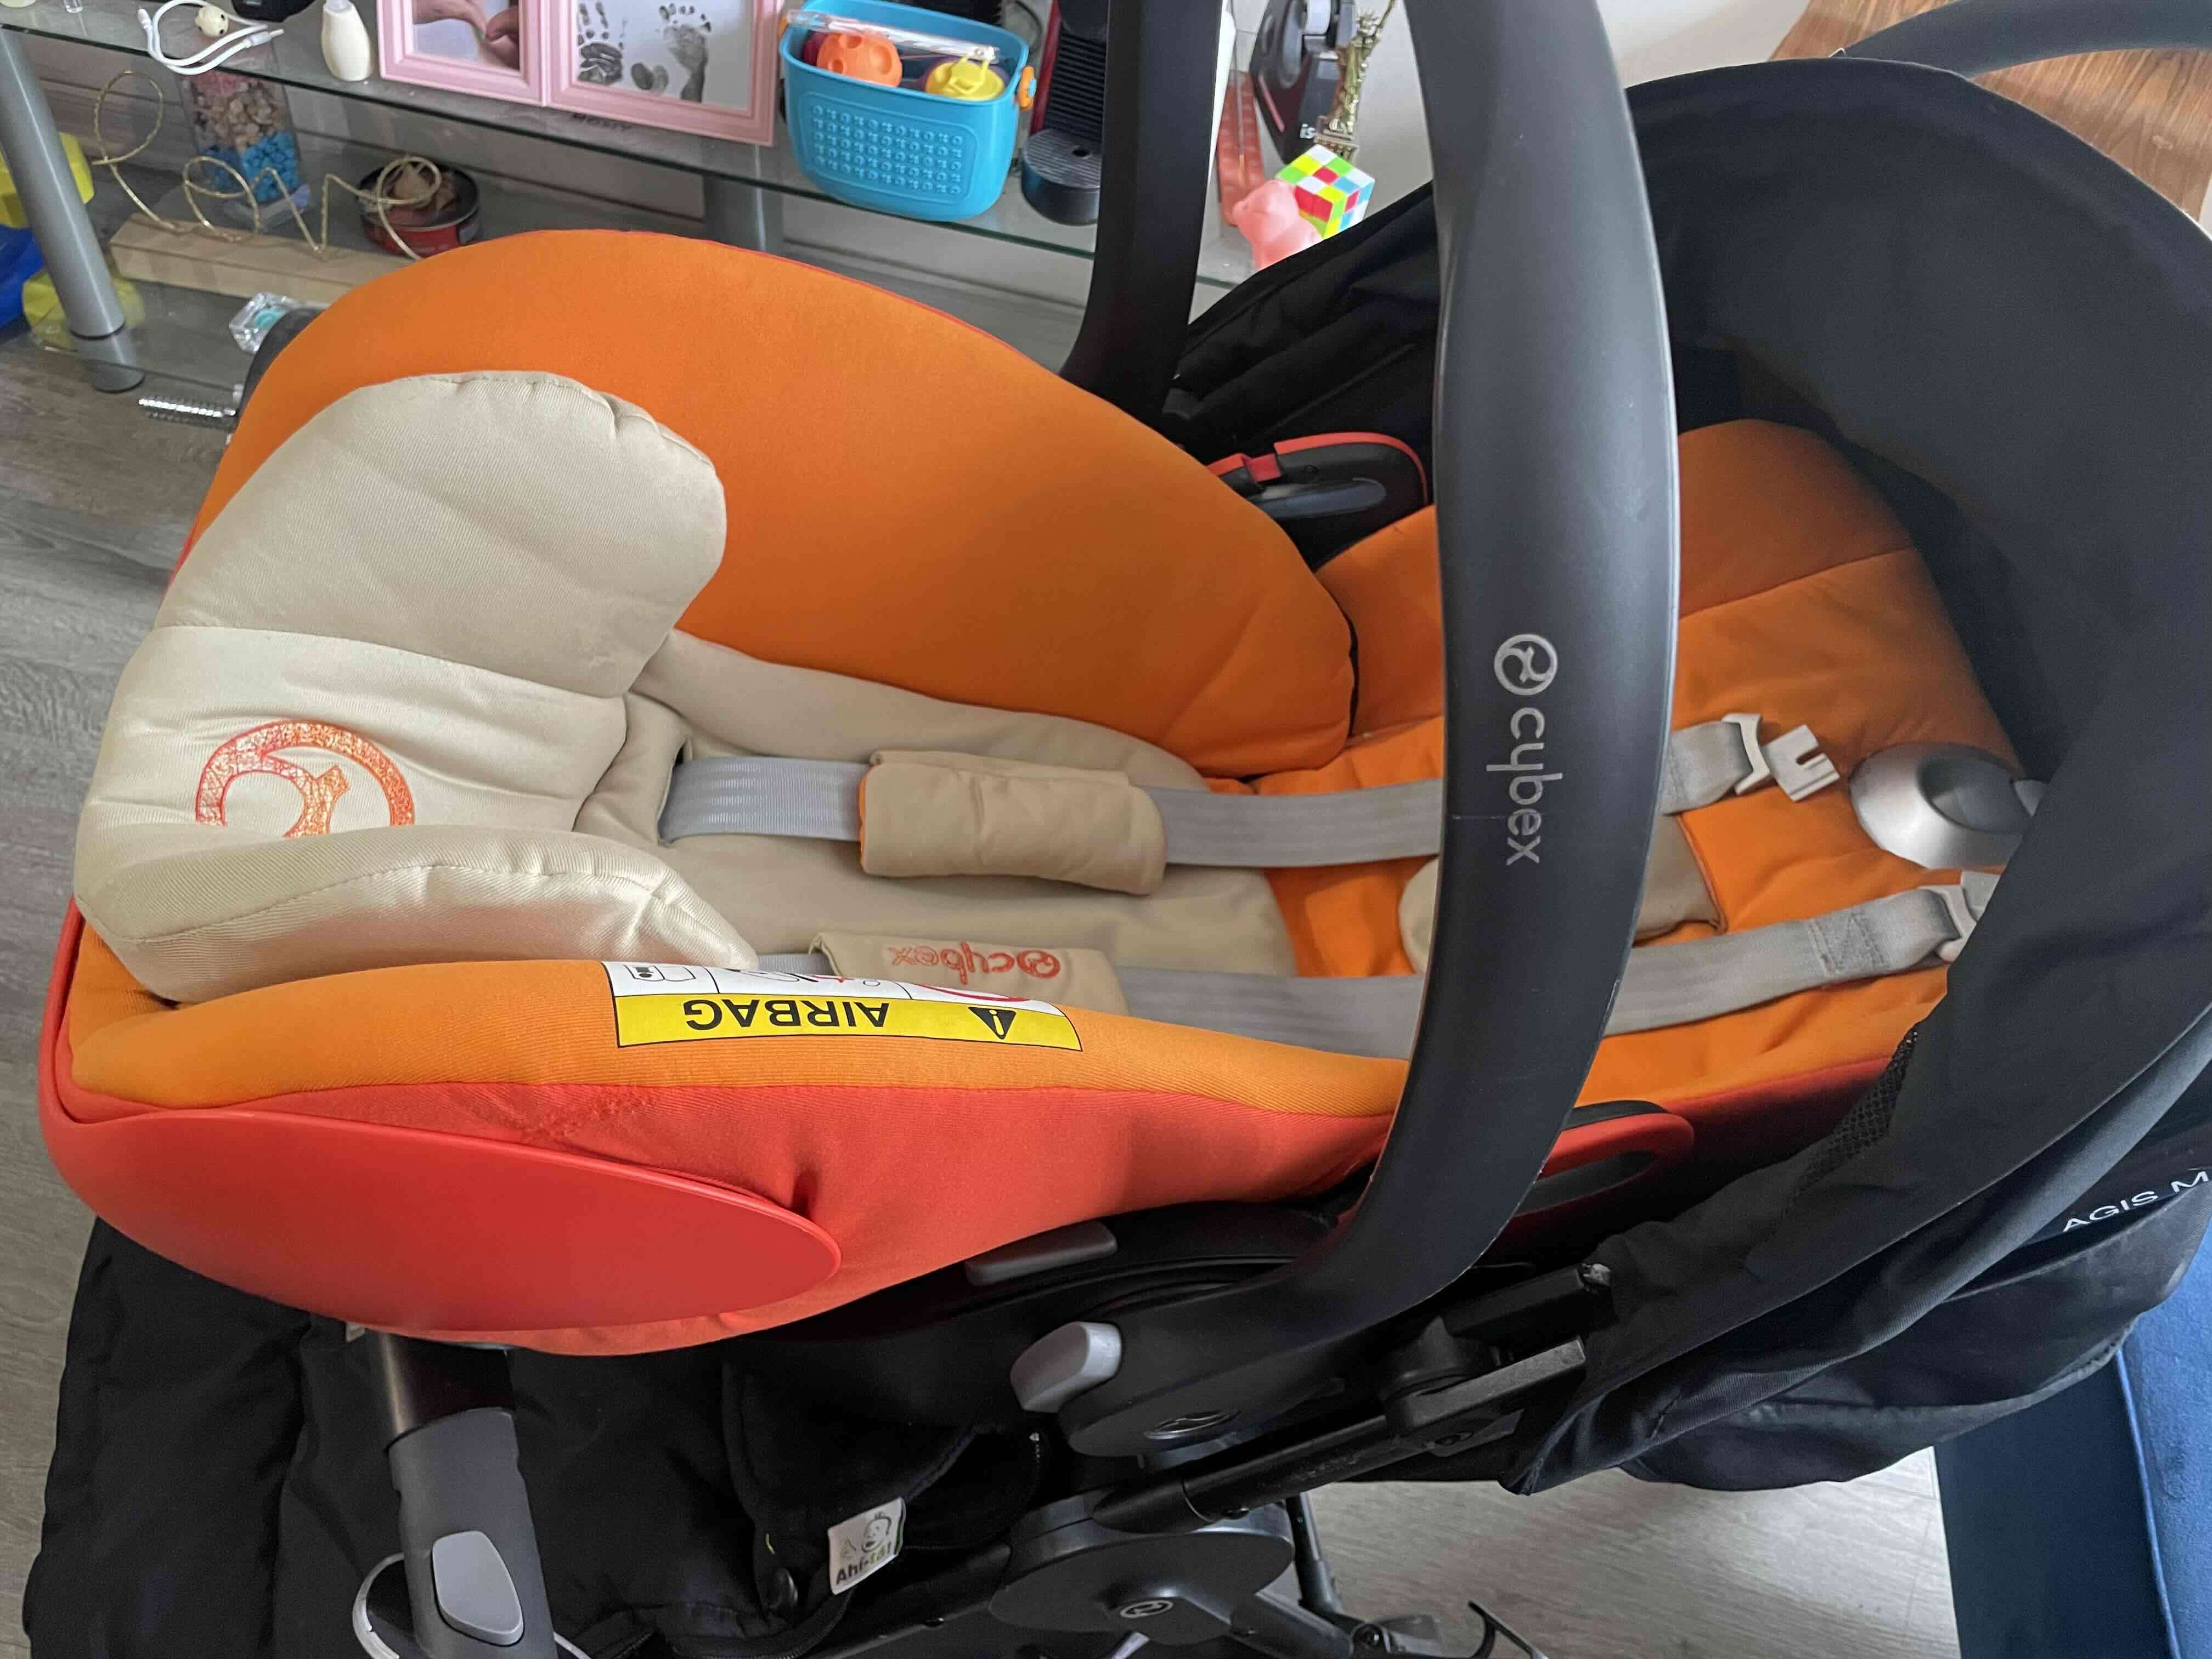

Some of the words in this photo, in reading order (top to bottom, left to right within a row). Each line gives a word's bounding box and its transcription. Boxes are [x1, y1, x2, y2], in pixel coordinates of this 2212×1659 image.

[1486, 707, 1562, 866] cybex
[887, 942, 1014, 985] cybex
[684, 1000, 889, 1030] AIRBAG
[2063, 1191, 2159, 1232] AGIS
